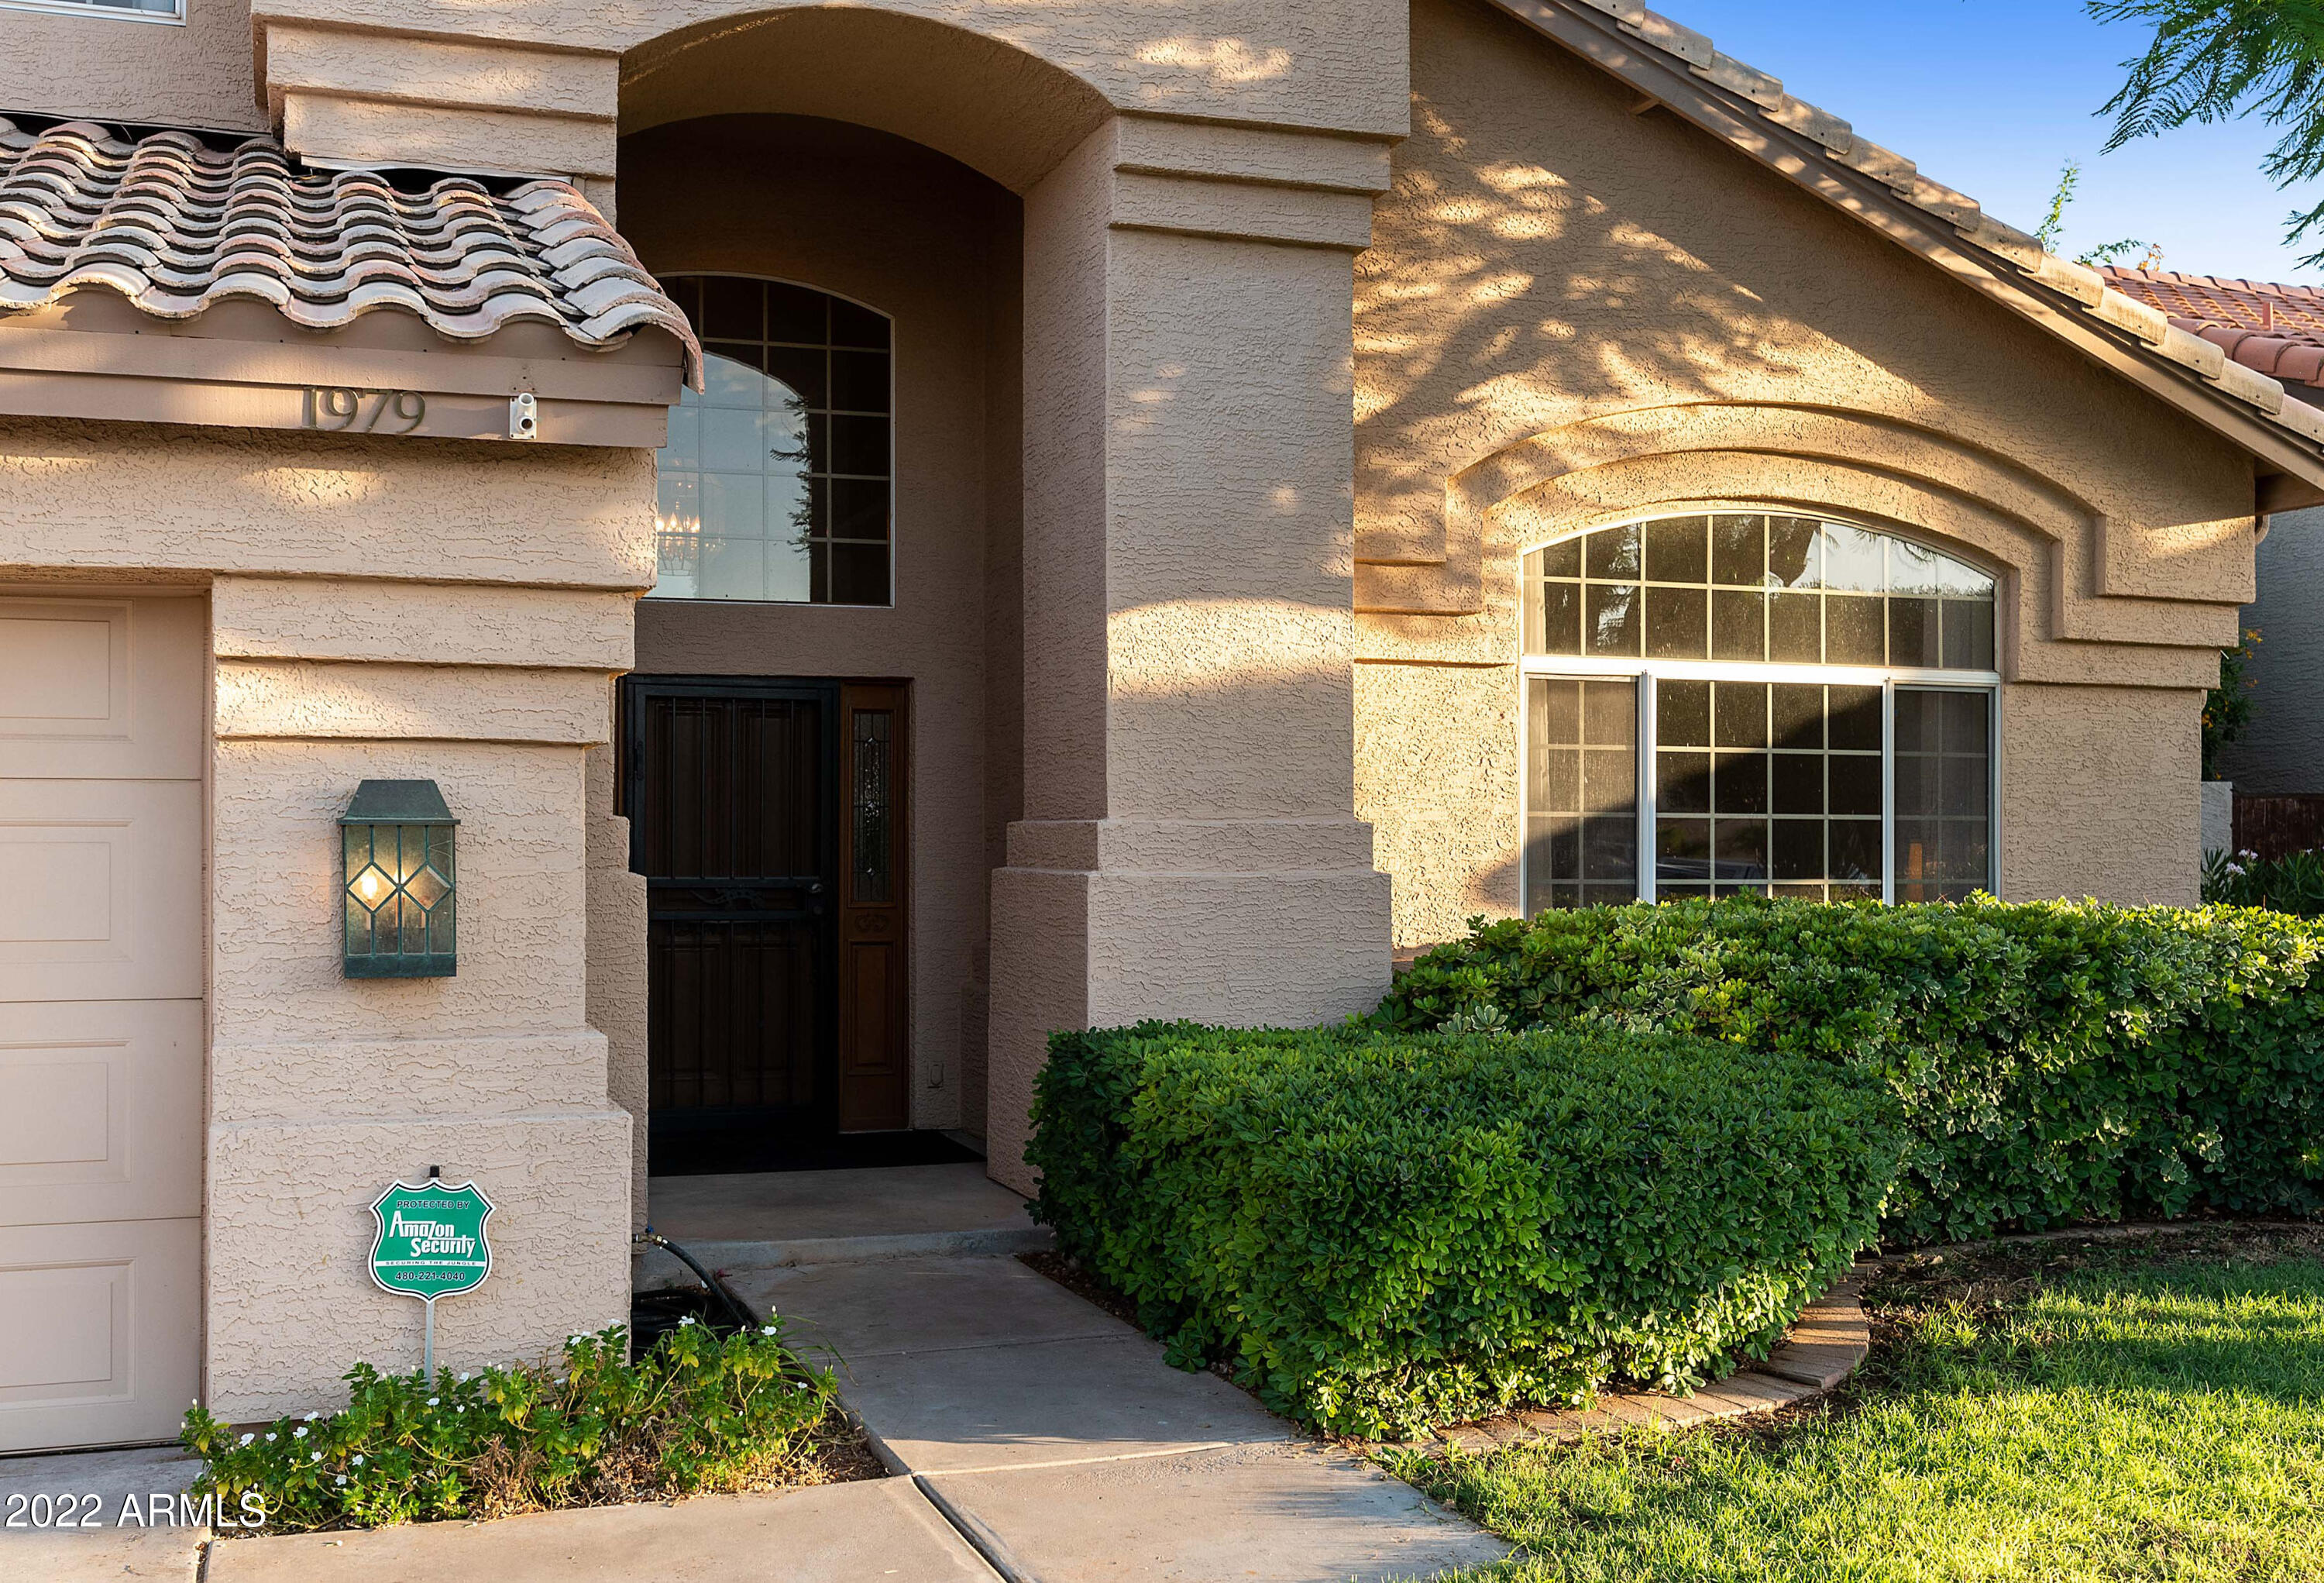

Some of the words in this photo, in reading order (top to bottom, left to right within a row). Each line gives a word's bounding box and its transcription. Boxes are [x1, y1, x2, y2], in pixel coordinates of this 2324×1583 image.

[304, 386, 425, 433] 1979
[397, 1200, 454, 1209] PROTECTED
[389, 1210, 455, 1240] Amazon
[410, 1234, 476, 1258] Security
[395, 1272, 466, 1281] 480-221-4040
